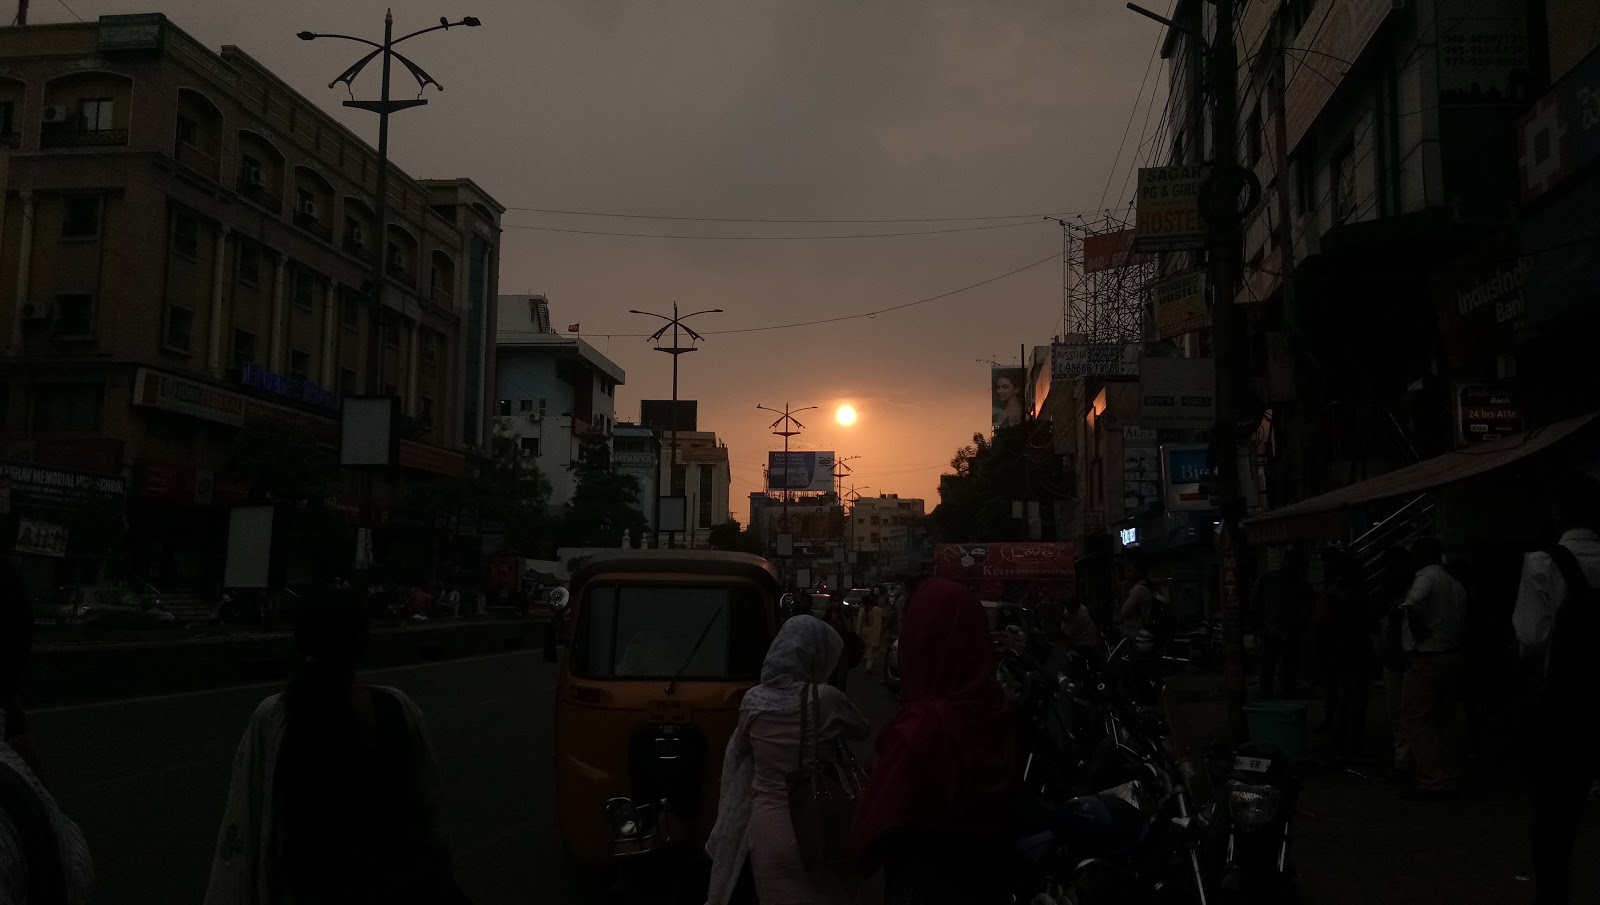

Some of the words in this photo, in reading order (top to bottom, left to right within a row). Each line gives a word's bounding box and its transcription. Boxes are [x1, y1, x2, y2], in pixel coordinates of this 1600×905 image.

[1147, 166, 1201, 182] SAGAR
[1143, 186, 1158, 199] PG
[1161, 185, 1169, 198] &
[1159, 284, 1200, 305] HOSTEL
[1489, 396, 1511, 404] Bank
[1468, 410, 1479, 418] 24
[1481, 410, 1495, 418] hrs
[1496, 410, 1517, 418] ATM
[33, 469, 76, 488] MEMORIAL
[96, 478, 124, 494] SCHOOL
